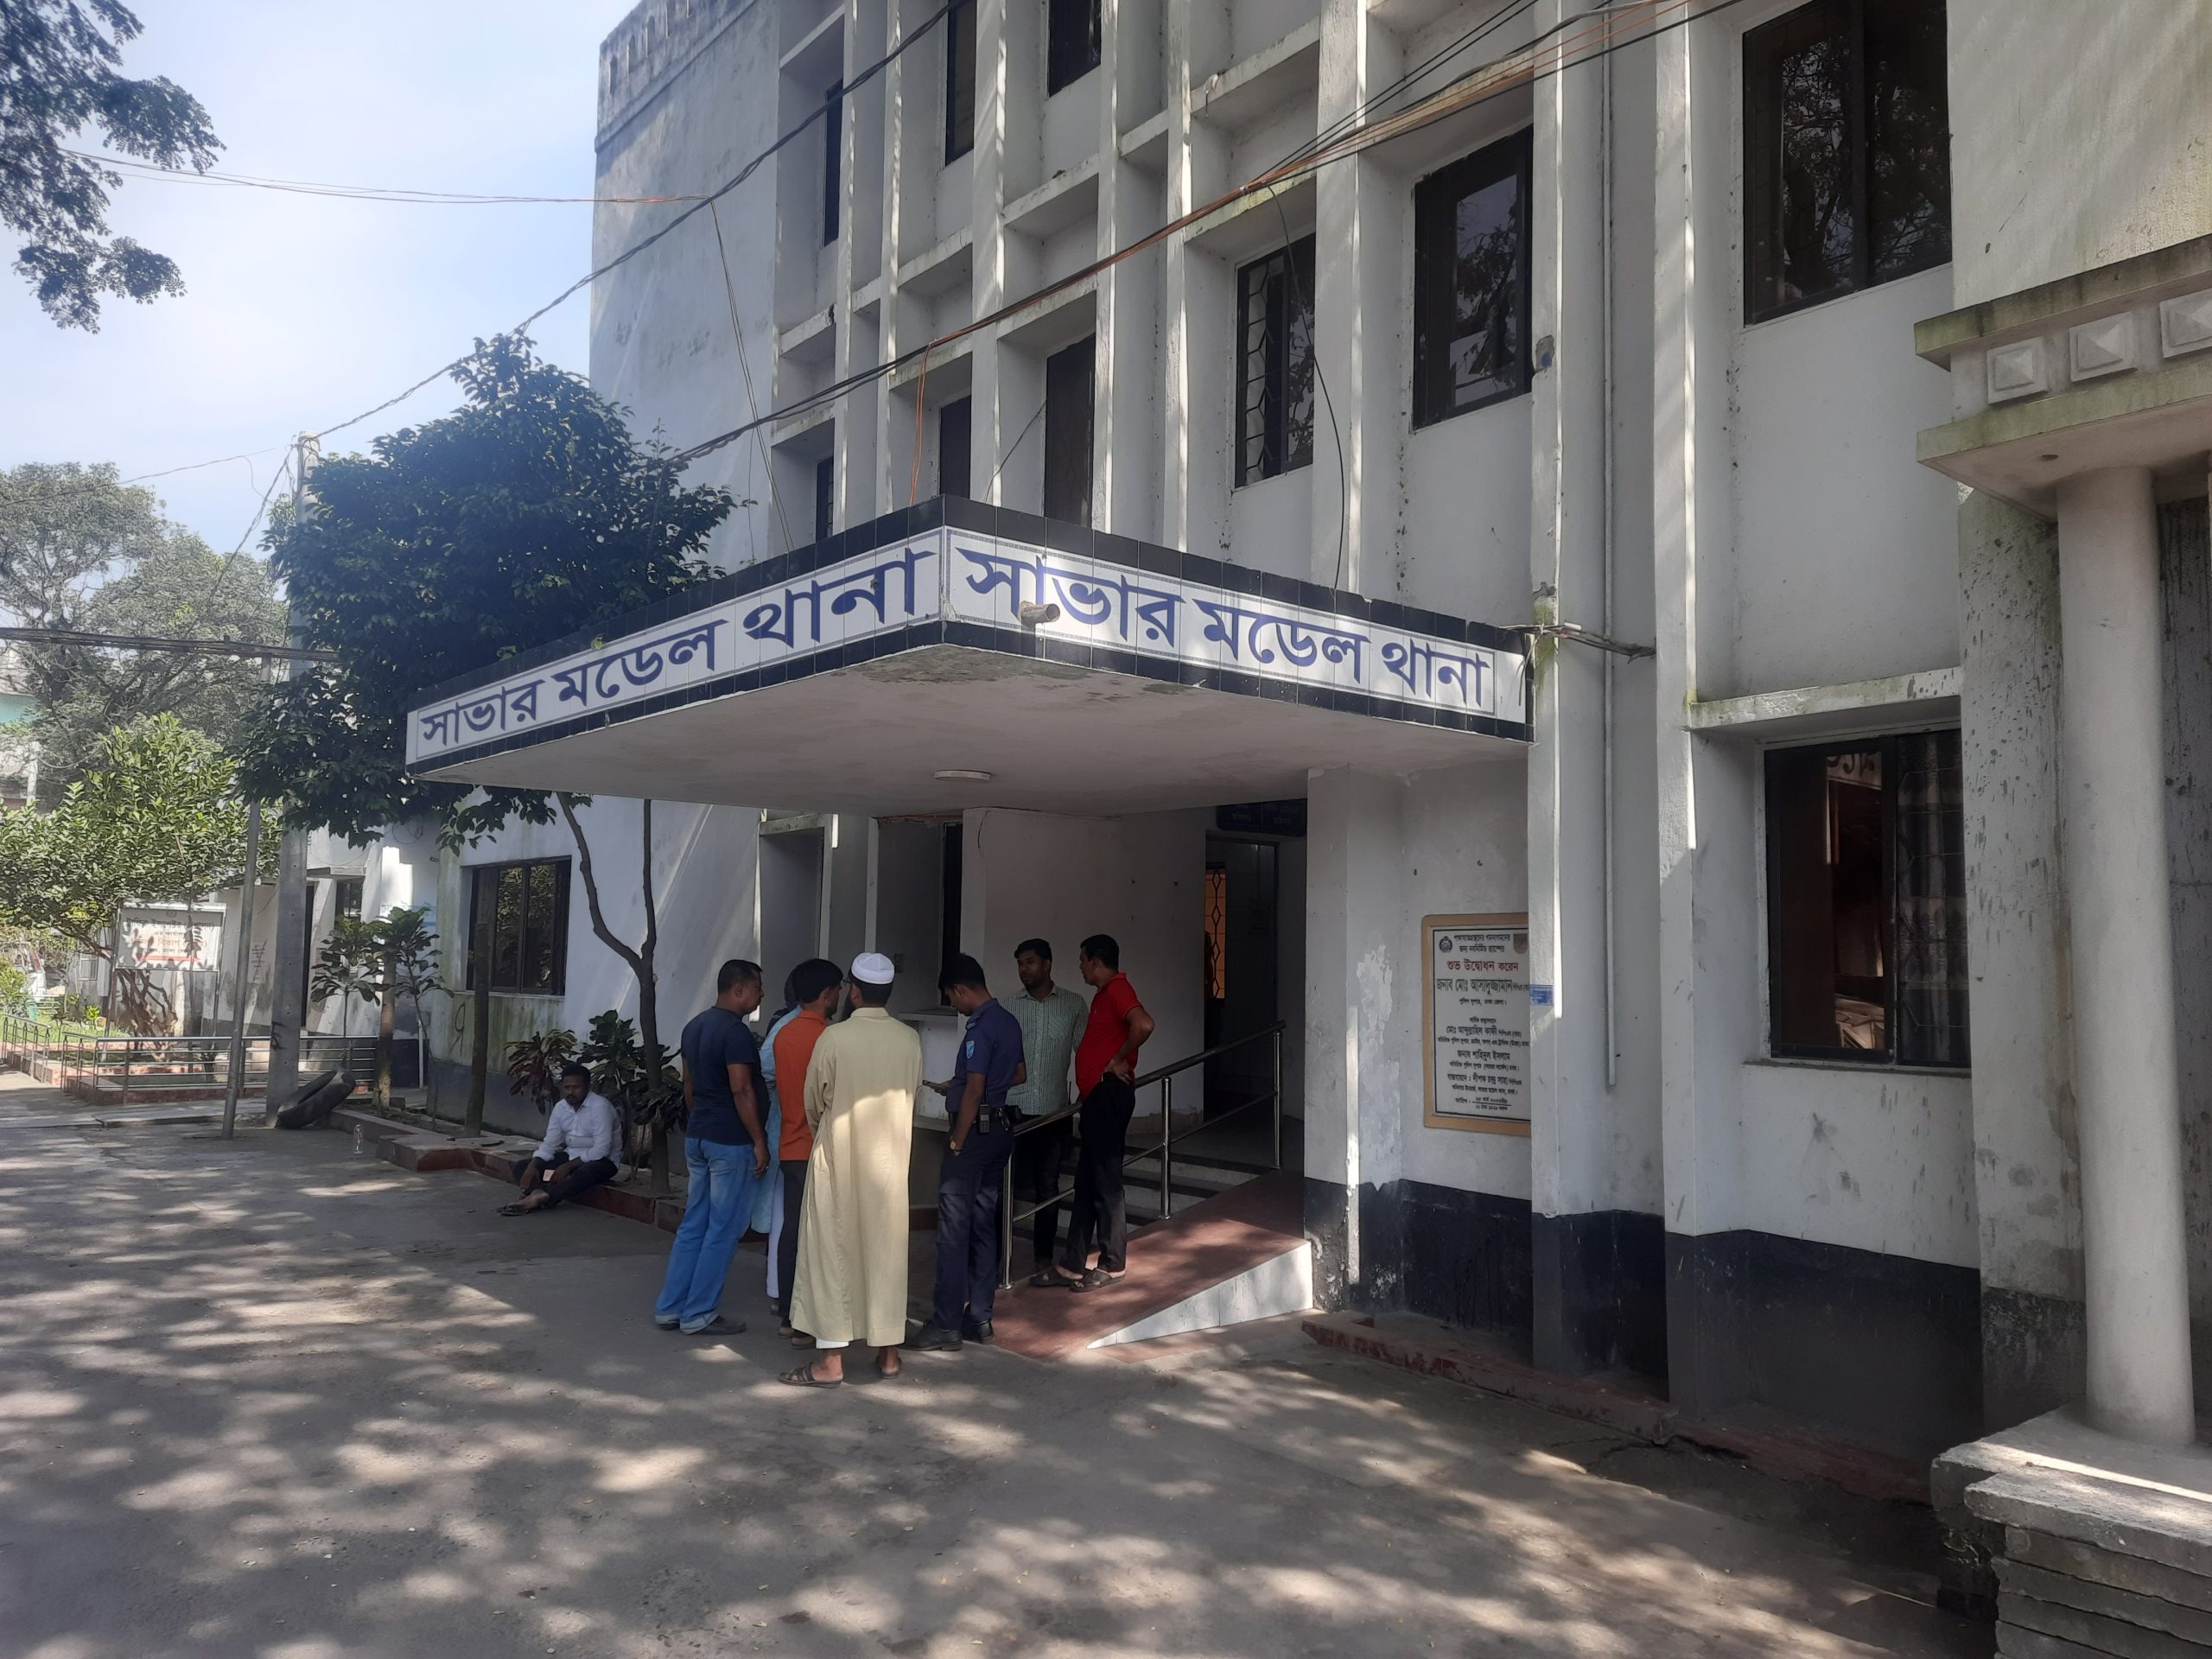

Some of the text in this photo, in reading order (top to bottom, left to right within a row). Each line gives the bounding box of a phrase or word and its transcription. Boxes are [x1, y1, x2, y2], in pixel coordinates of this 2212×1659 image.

[421, 547, 939, 747] সাভার মডেল থানা
[956, 547, 1496, 709] সাভার মডেল থানা
[1436, 978, 1452, 991] জনাব
[1470, 979, 1512, 995] আসাদুজ্জামান
[1447, 958, 1519, 971] শুভ উদ্বোধন করেন
